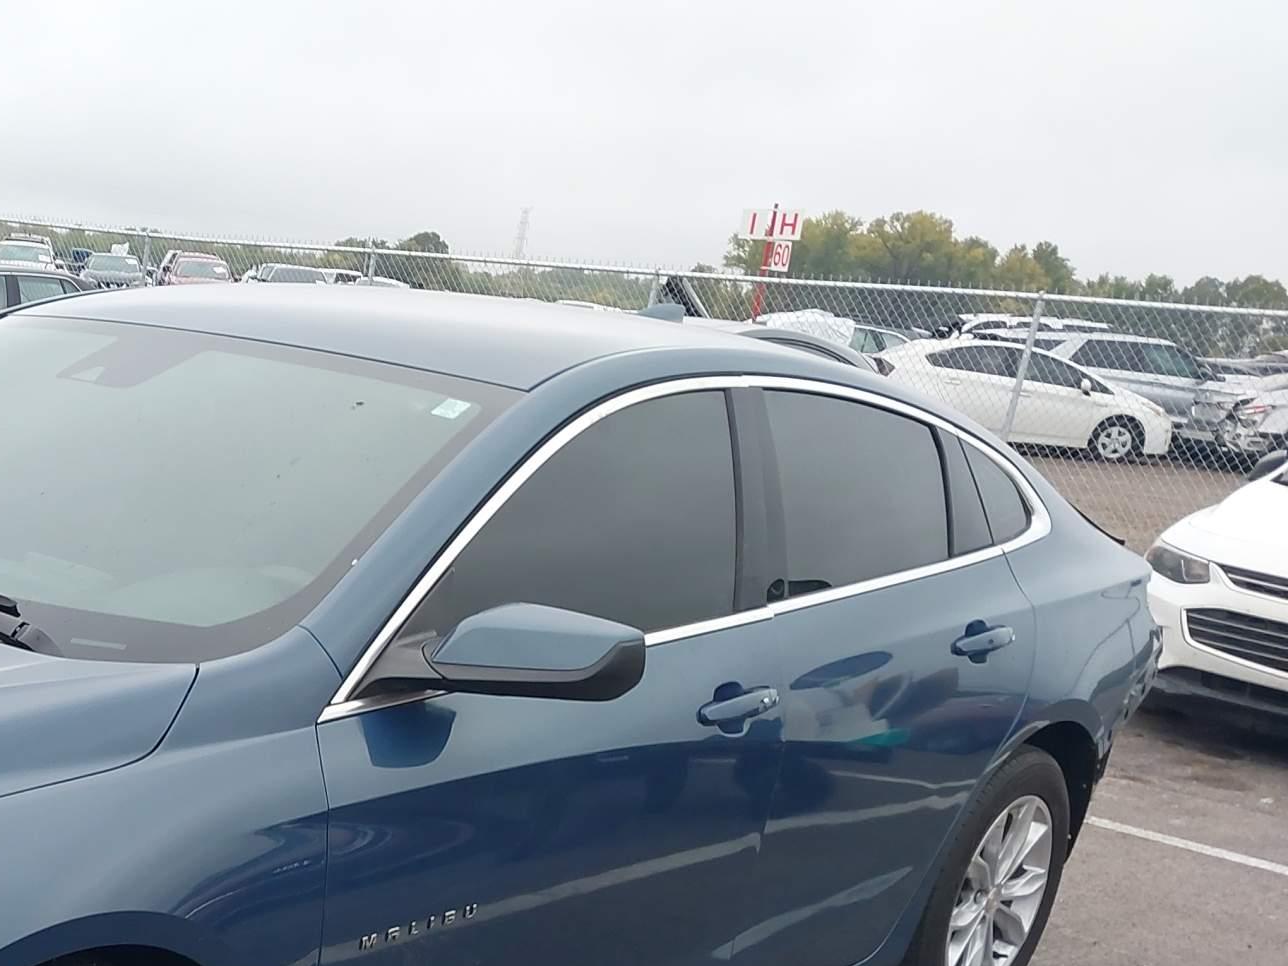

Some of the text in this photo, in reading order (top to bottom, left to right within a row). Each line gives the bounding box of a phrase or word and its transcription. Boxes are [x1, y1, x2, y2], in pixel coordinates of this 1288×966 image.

[779, 212, 799, 235] H
[773, 243, 790, 267] 60
[359, 903, 478, 951] MALIBU
